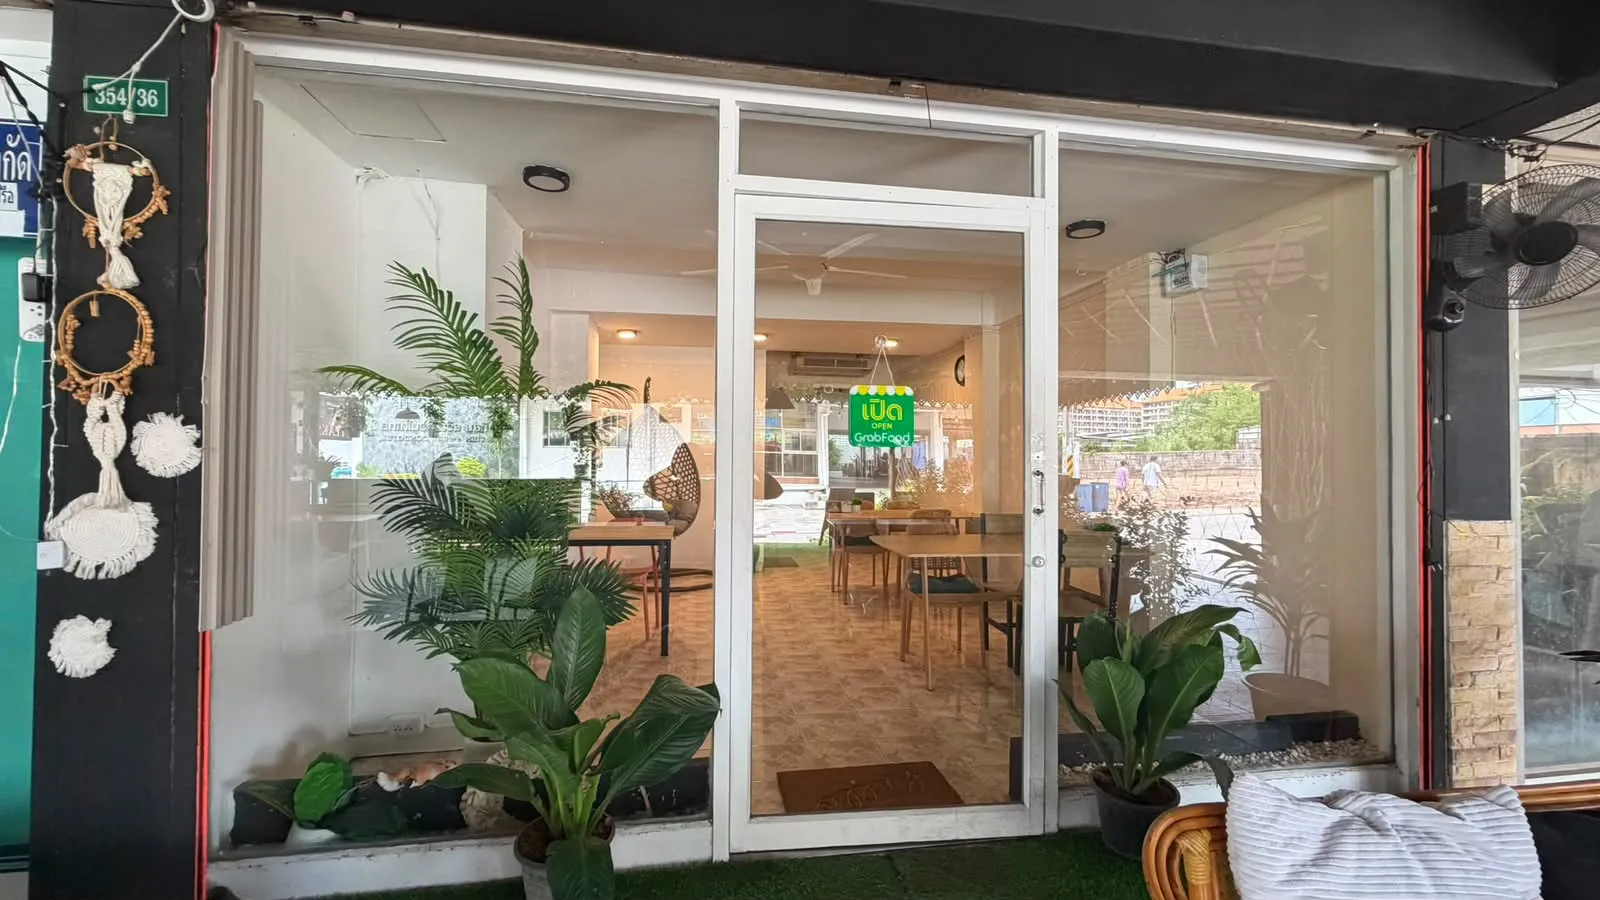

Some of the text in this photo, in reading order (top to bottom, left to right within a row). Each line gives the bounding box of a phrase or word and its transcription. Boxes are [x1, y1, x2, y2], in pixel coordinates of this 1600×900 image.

[94, 86, 159, 108] 354/36
[0, 133, 32, 181] กัด
[862, 398, 903, 421] เปิด
[854, 431, 911, 443] GrabFood
[871, 422, 893, 430] OPEN
